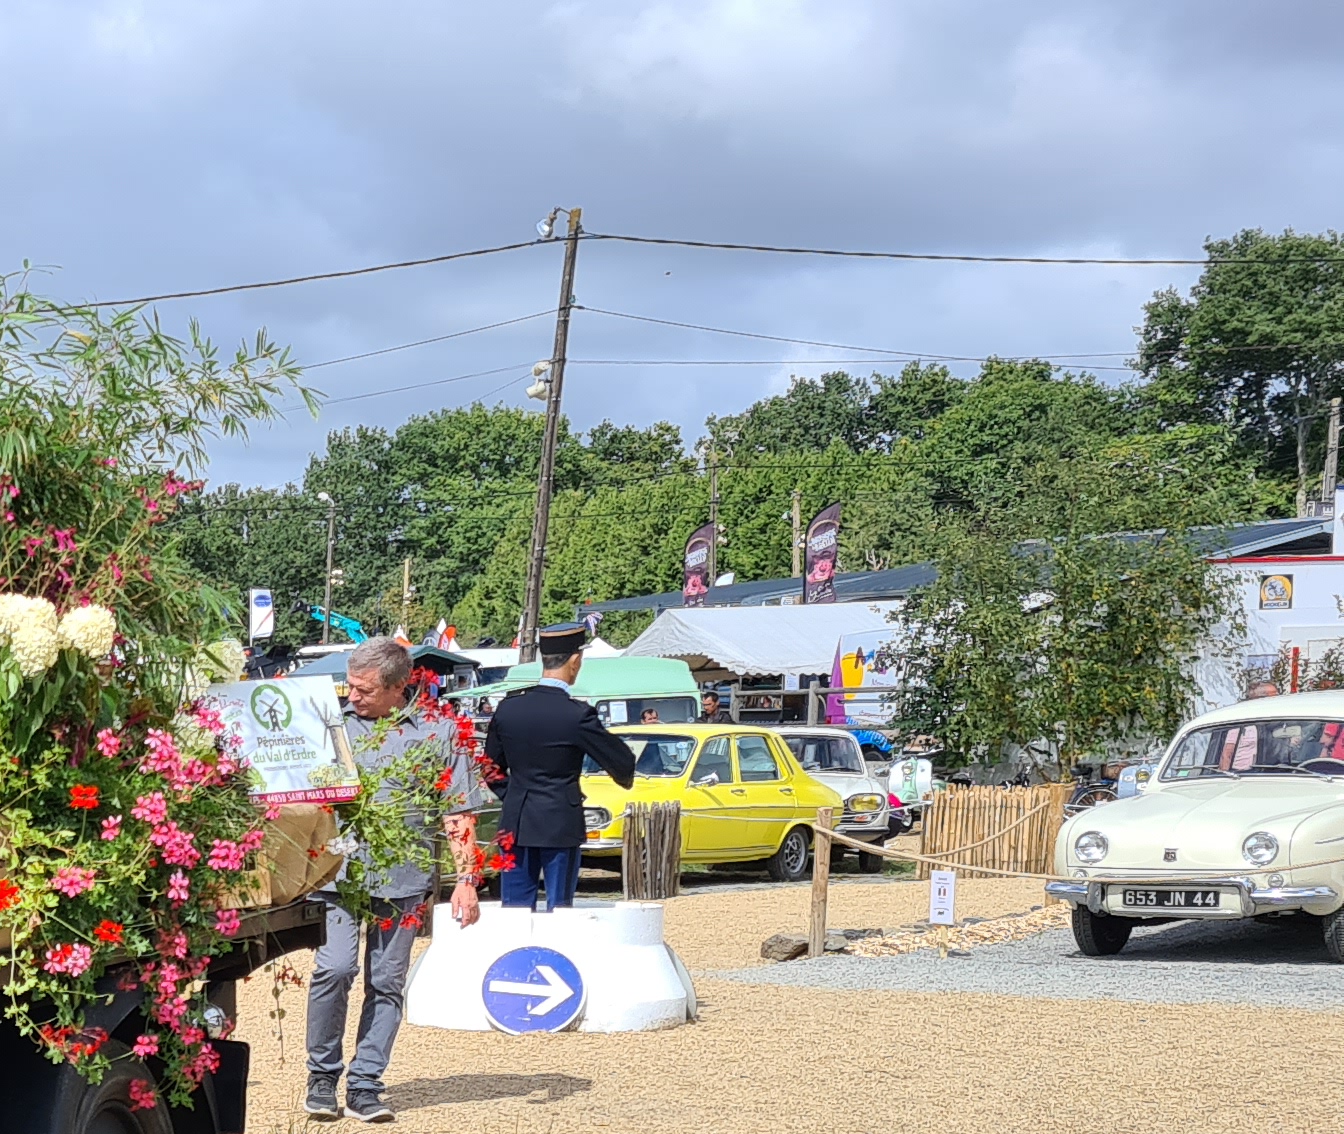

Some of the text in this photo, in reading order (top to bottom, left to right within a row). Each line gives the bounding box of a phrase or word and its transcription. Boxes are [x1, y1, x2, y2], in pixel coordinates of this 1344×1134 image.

[253, 747, 317, 764] du Val d'Erdre
[1125, 890, 1216, 906] 653 JN 44
